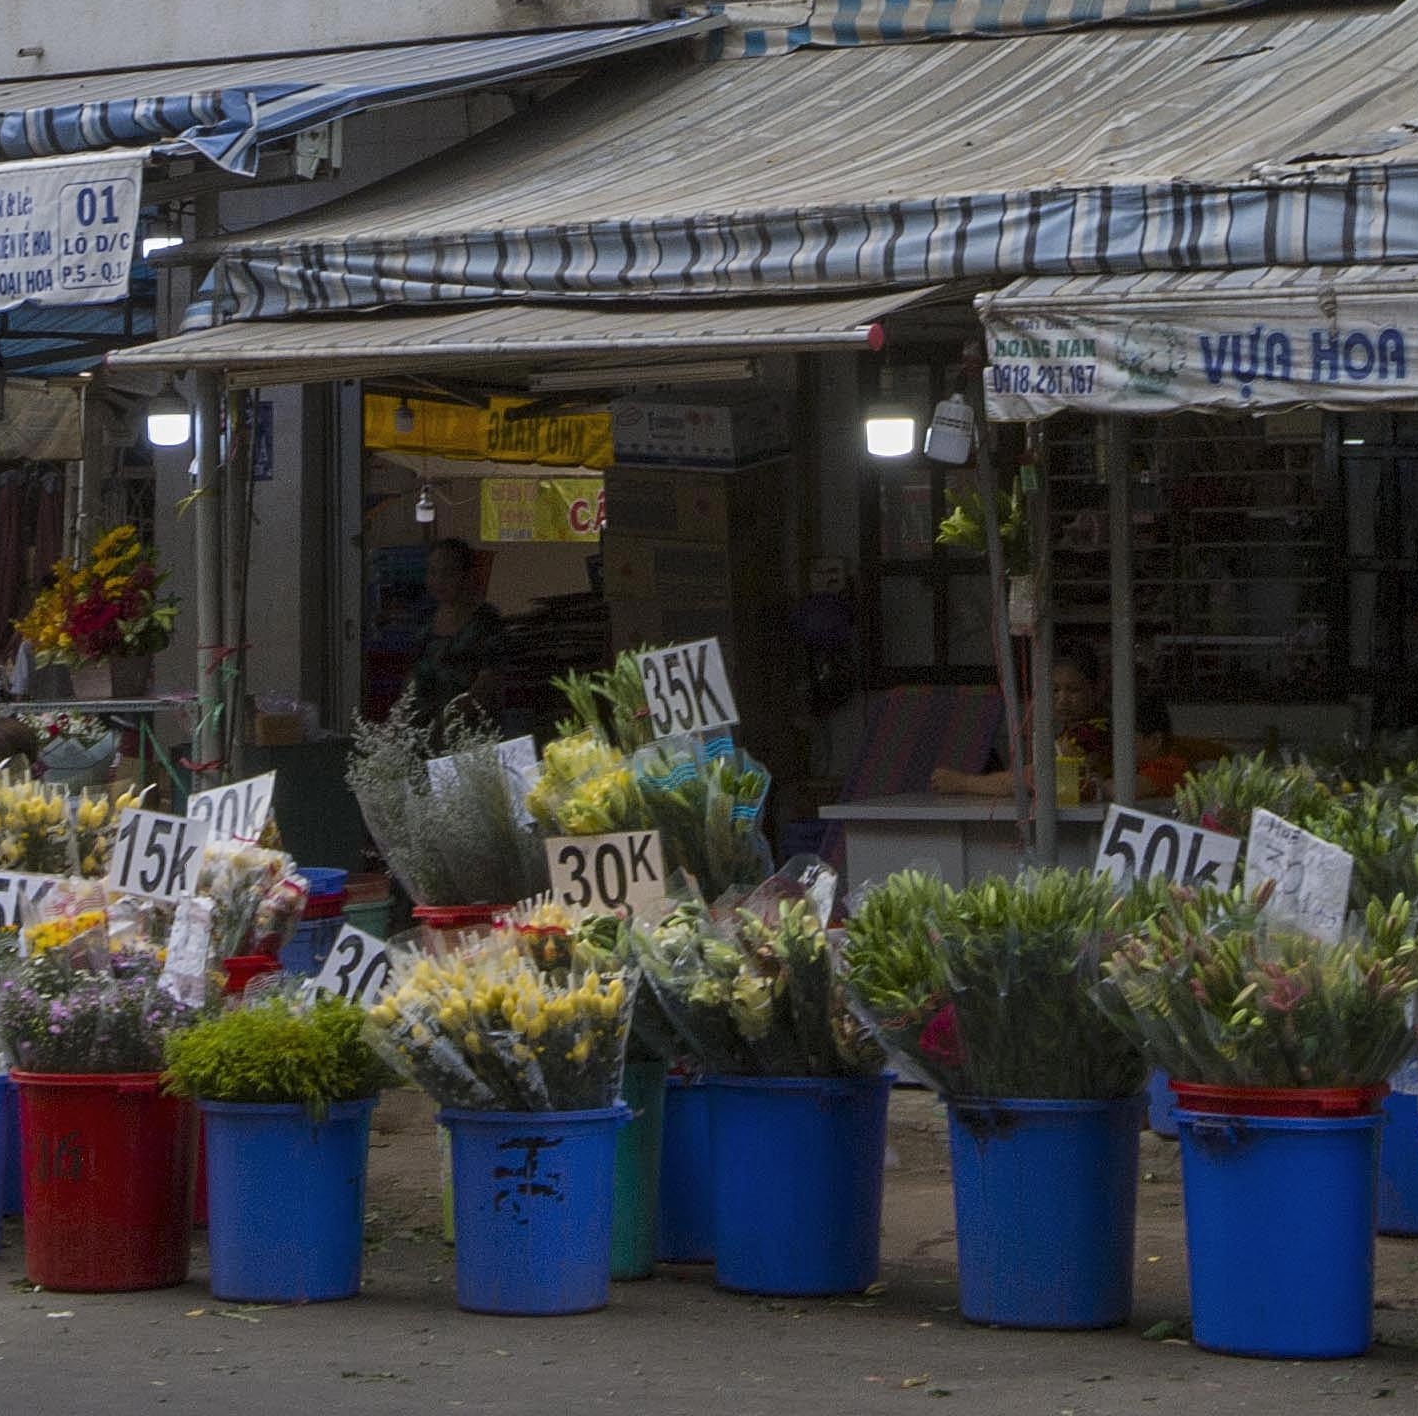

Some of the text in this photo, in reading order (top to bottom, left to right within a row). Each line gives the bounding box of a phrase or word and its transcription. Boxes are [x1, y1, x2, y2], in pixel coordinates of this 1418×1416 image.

[76, 185, 120, 227] 01
[96, 232, 131, 253] D/C
[26, 269, 53, 292] HOA
[1198, 324, 1291, 399] VỰA
[1311, 328, 1405, 383] HOA
[644, 645, 731, 736] 35K
[558, 834, 658, 916] 30K
